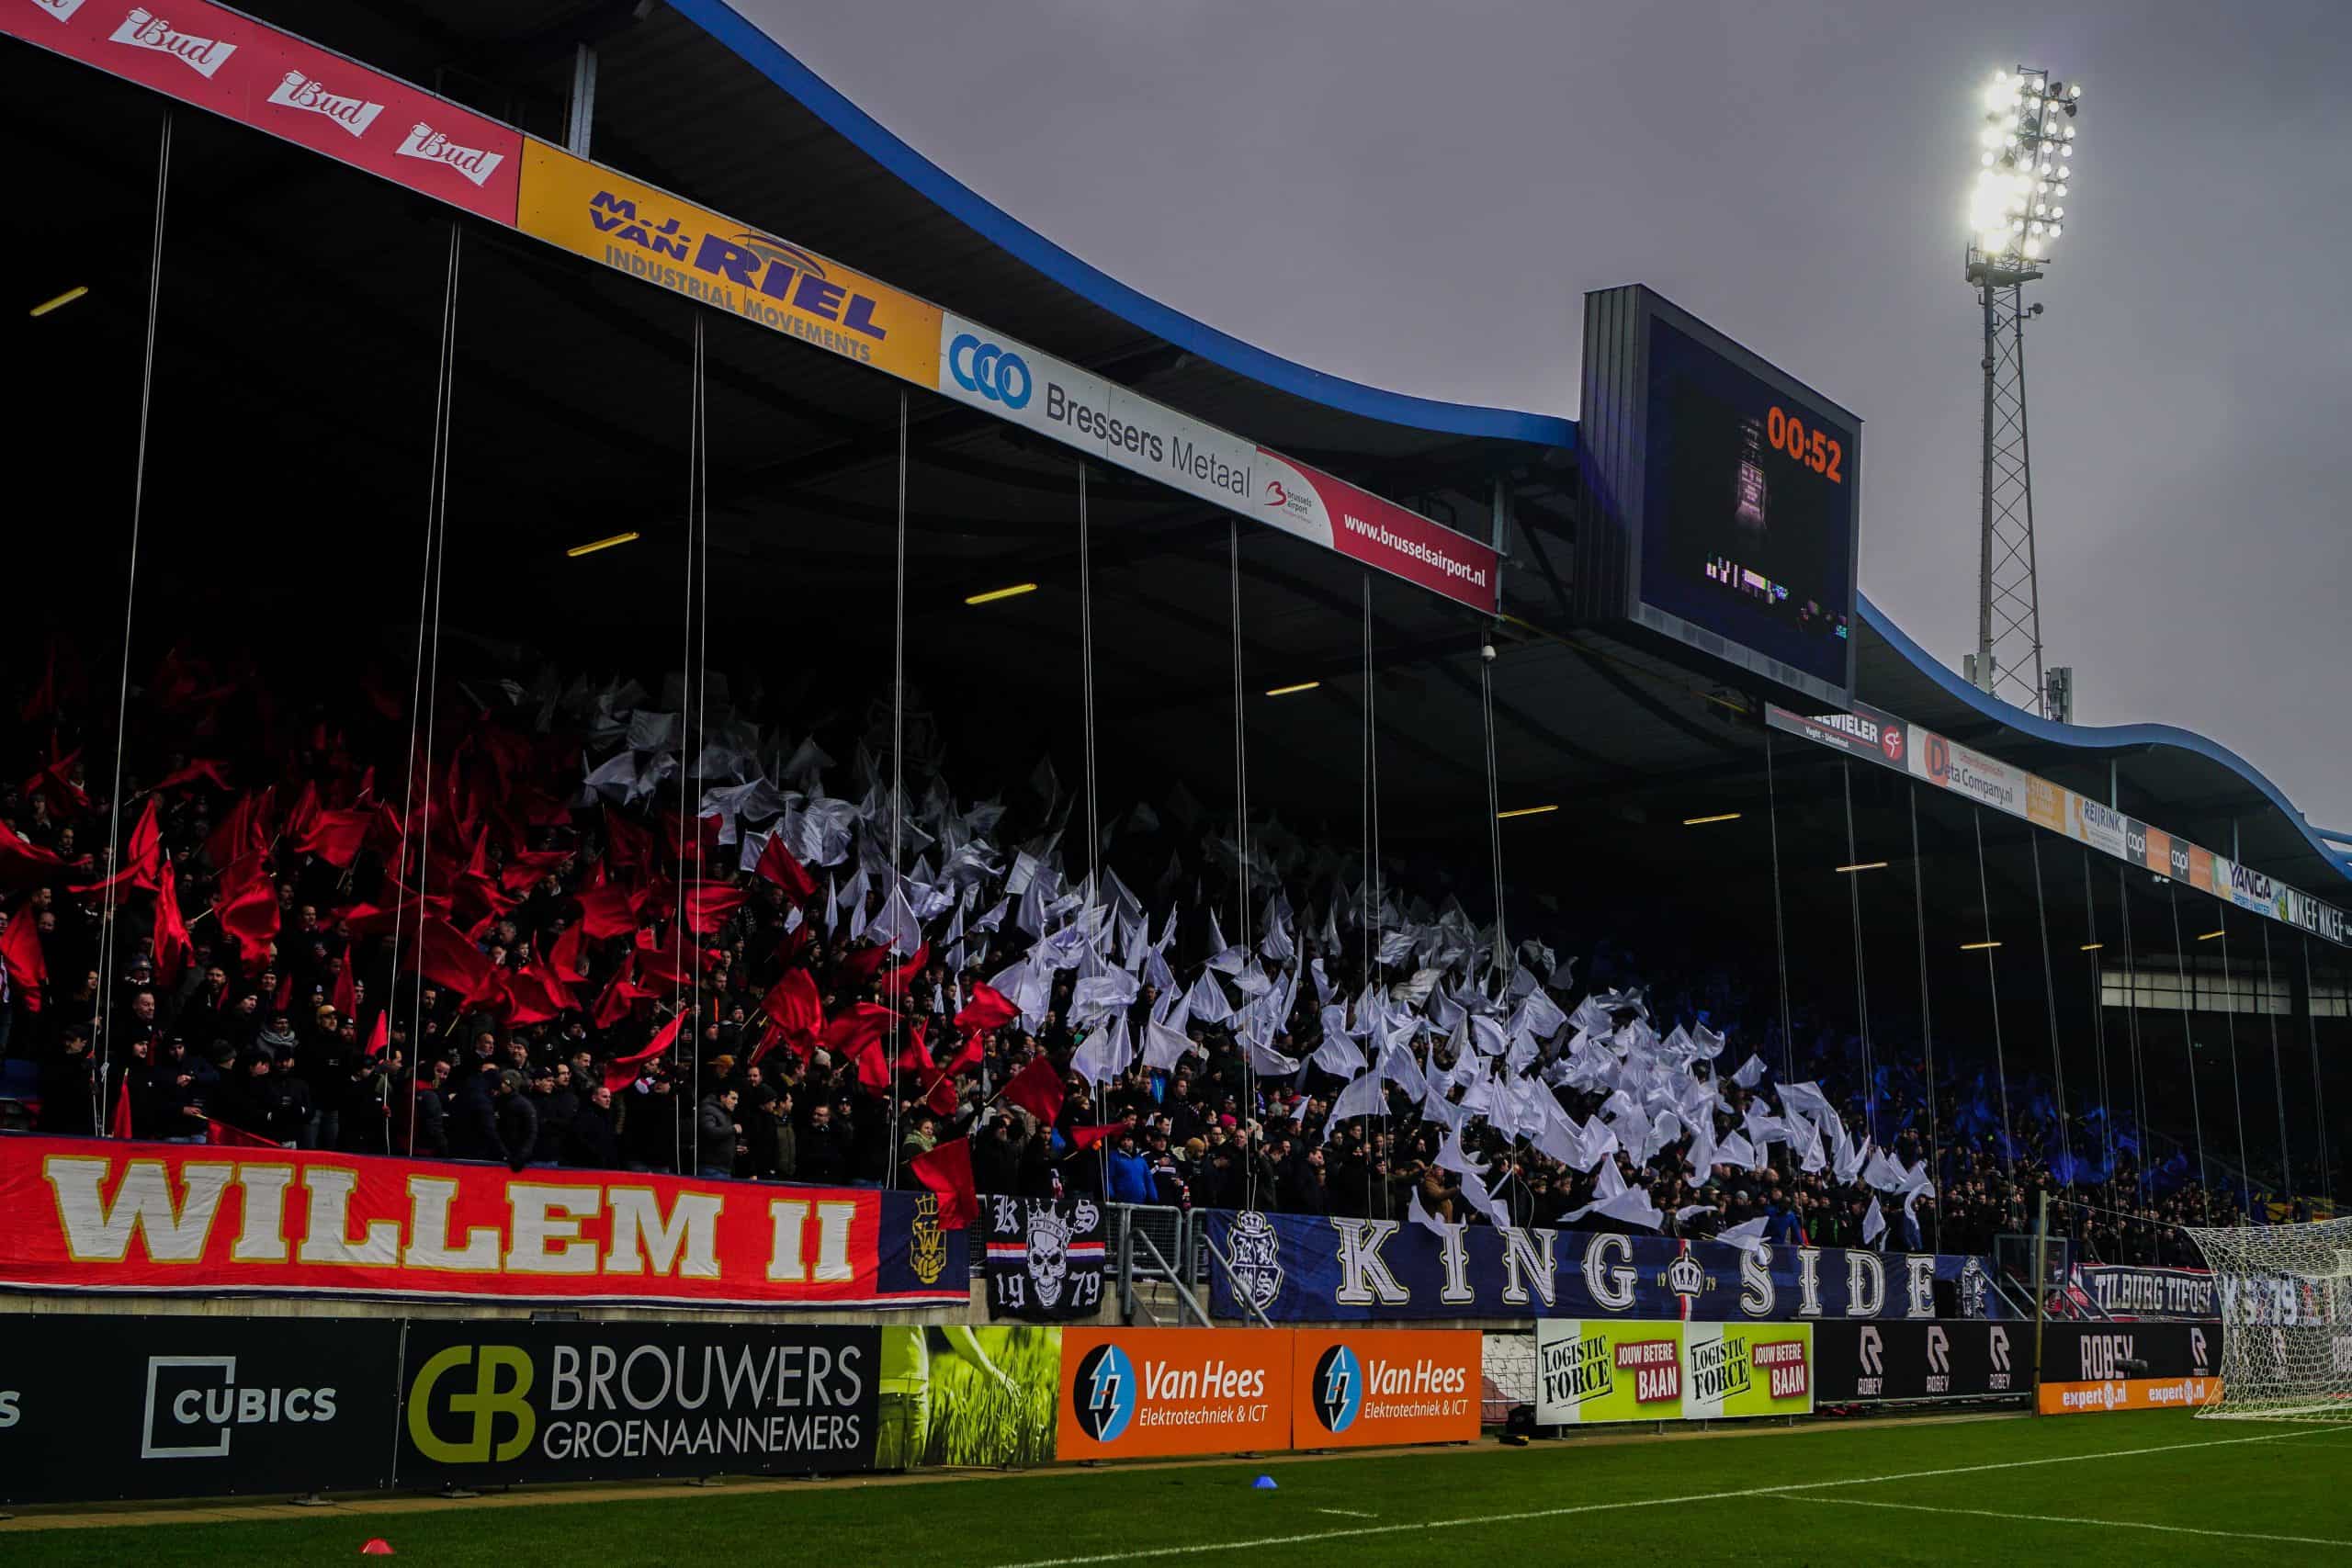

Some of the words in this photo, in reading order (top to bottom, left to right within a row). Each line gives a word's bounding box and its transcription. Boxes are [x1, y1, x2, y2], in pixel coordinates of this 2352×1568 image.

[129, 6, 214, 65] Bud
[284, 70, 364, 125] Bud
[411, 121, 487, 175] Bud
[590, 190, 691, 243] M.J.
[589, 209, 689, 262] VAN
[694, 233, 887, 341] RIEL
[605, 244, 736, 311] INDUSTRIAL
[743, 300, 872, 362] MOVEMENTS
[1046, 382, 1163, 462] Bressers
[1171, 436, 1250, 498] Metaal
[1768, 406, 1842, 483] 00:52
[1344, 513, 1486, 587] www.brusselsairport.nl
[1962, 768, 2013, 805] Company.nl
[2127, 832, 2146, 859] capi
[2172, 850, 2188, 874] capi
[2229, 862, 2271, 899] YANGA
[43, 1154, 724, 1280] WILLEM
[766, 1200, 855, 1281] II
[1330, 1215, 1638, 1311] KING
[1739, 1243, 1936, 1318] SIDE
[996, 1272, 1025, 1308] 19
[1069, 1270, 1102, 1308] 79
[2095, 1272, 2163, 1310] TILBURG
[1542, 1336, 1607, 1373] LOGISTIC
[1617, 1346, 1642, 1364] JOUW
[1644, 1343, 1674, 1362] BETERE
[1691, 1337, 1746, 1371] LOGISTIC
[1754, 1346, 1775, 1363] JOUW
[1776, 1343, 1802, 1361] BETERE
[2080, 1335, 2134, 1380] ROBEY
[551, 1345, 862, 1411] BROUWERS
[1145, 1360, 1197, 1400] Van
[1201, 1359, 1265, 1399] Hees
[1368, 1359, 1411, 1394] Van
[1413, 1359, 1465, 1393] Hees
[1544, 1359, 1611, 1404] FORCE
[1638, 1367, 1677, 1399] BAAN
[1693, 1359, 1749, 1400] FORCE
[1771, 1366, 1805, 1396] BAAN
[1858, 1377, 1883, 1395] ROBEY
[1927, 1375, 1950, 1393] ROBEY
[1989, 1373, 2011, 1389] ROBEY
[173, 1387, 337, 1424] CUBICS
[1139, 1405, 1234, 1427] Elektrotechniek
[1236, 1406, 1247, 1423] &
[1249, 1404, 1268, 1422] ICT
[1364, 1400, 1441, 1418] Elektrotechniek
[1442, 1401, 1452, 1416] &
[1453, 1399, 1467, 1416] ICT
[543, 1415, 860, 1460] GROENAANNEMERS
